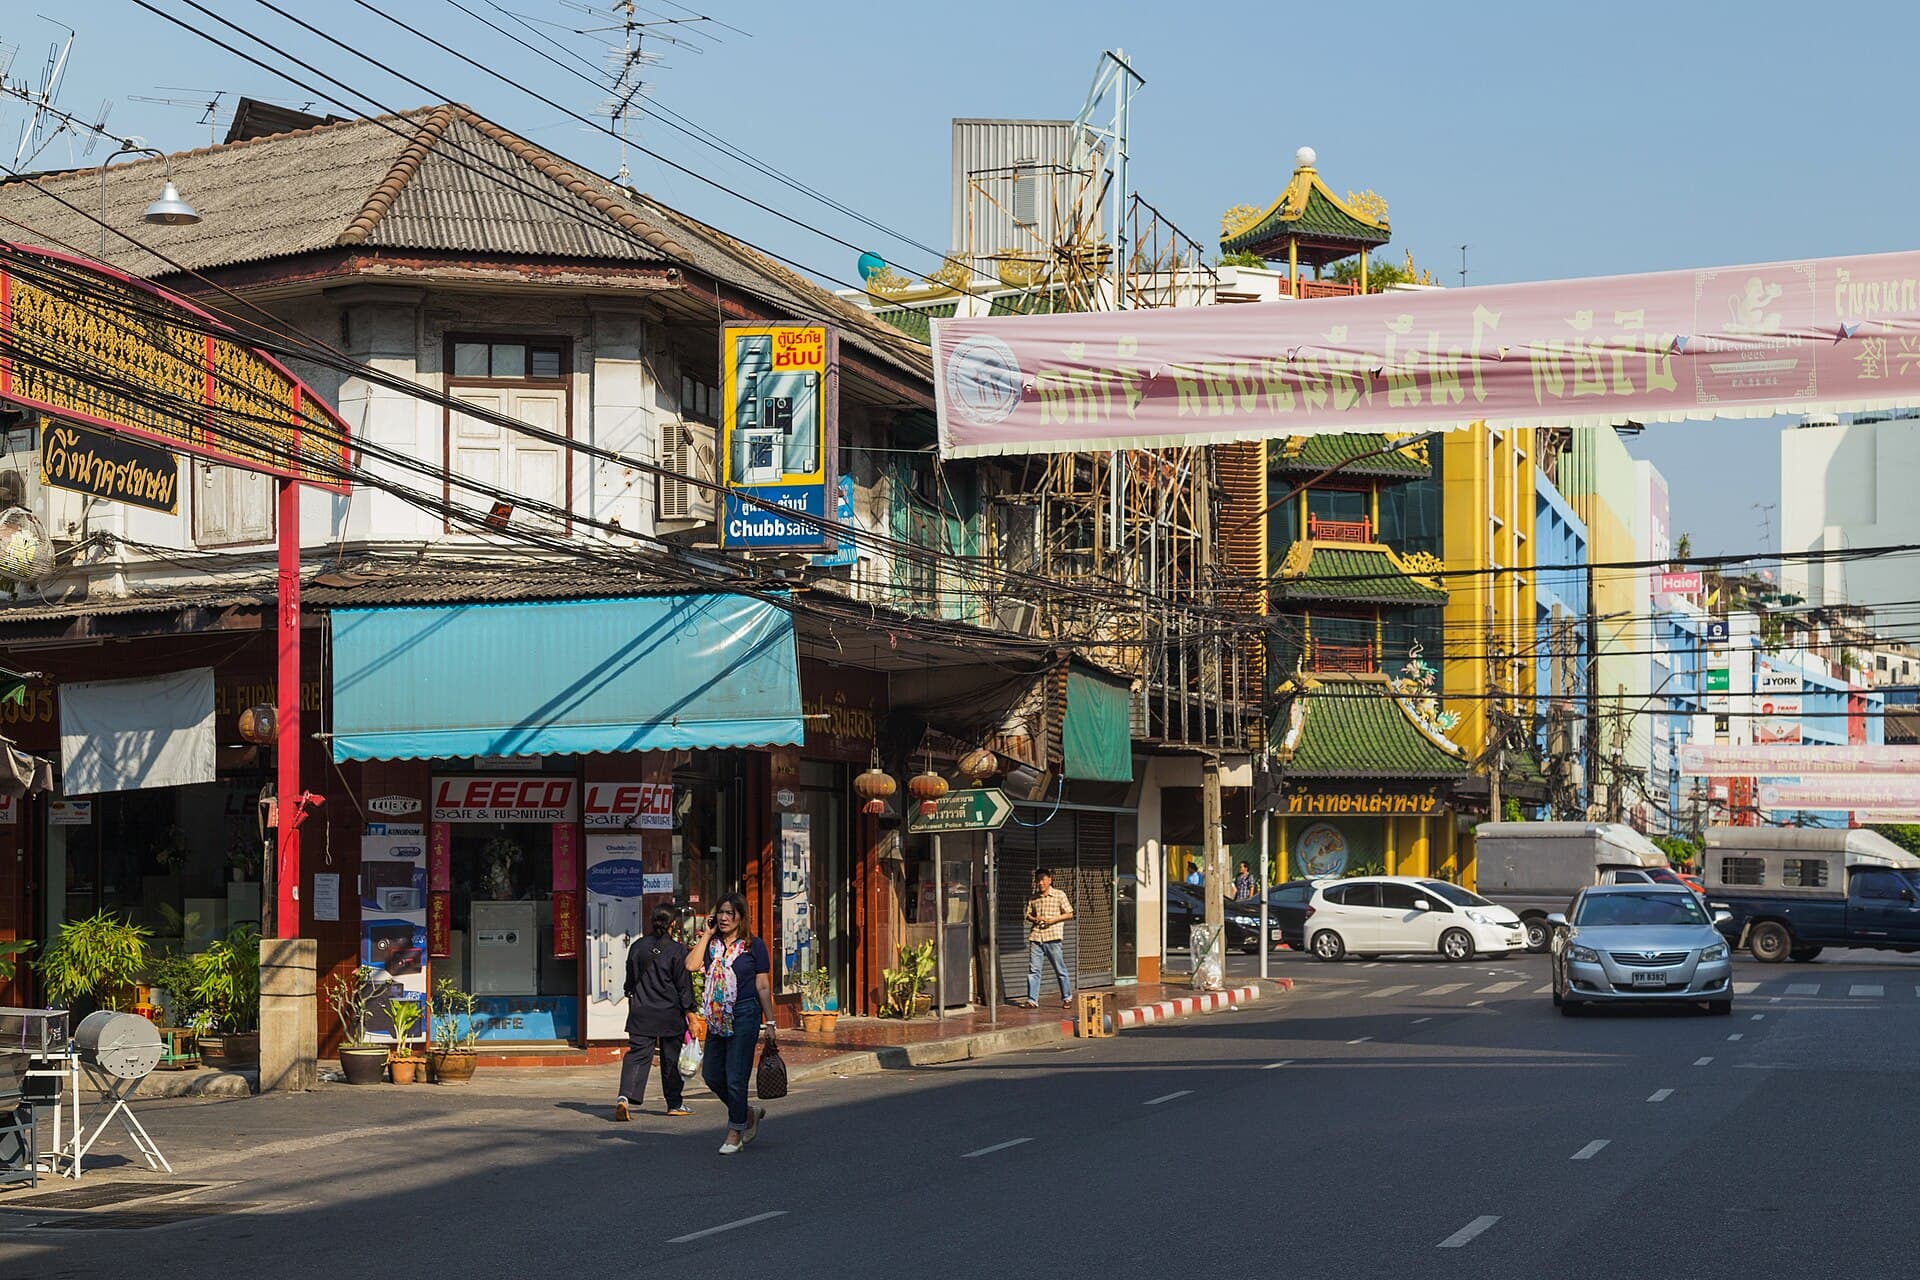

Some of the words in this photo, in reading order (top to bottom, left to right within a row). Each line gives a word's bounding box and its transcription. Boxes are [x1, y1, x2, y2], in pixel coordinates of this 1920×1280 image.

[1663, 577, 1699, 589] Haier
[1772, 677, 1797, 686] YORK
[436, 781, 571, 808] LEECO
[585, 787, 672, 814] LEECO
[476, 809, 489, 819] &
[494, 809, 566, 819] FURNITURE
